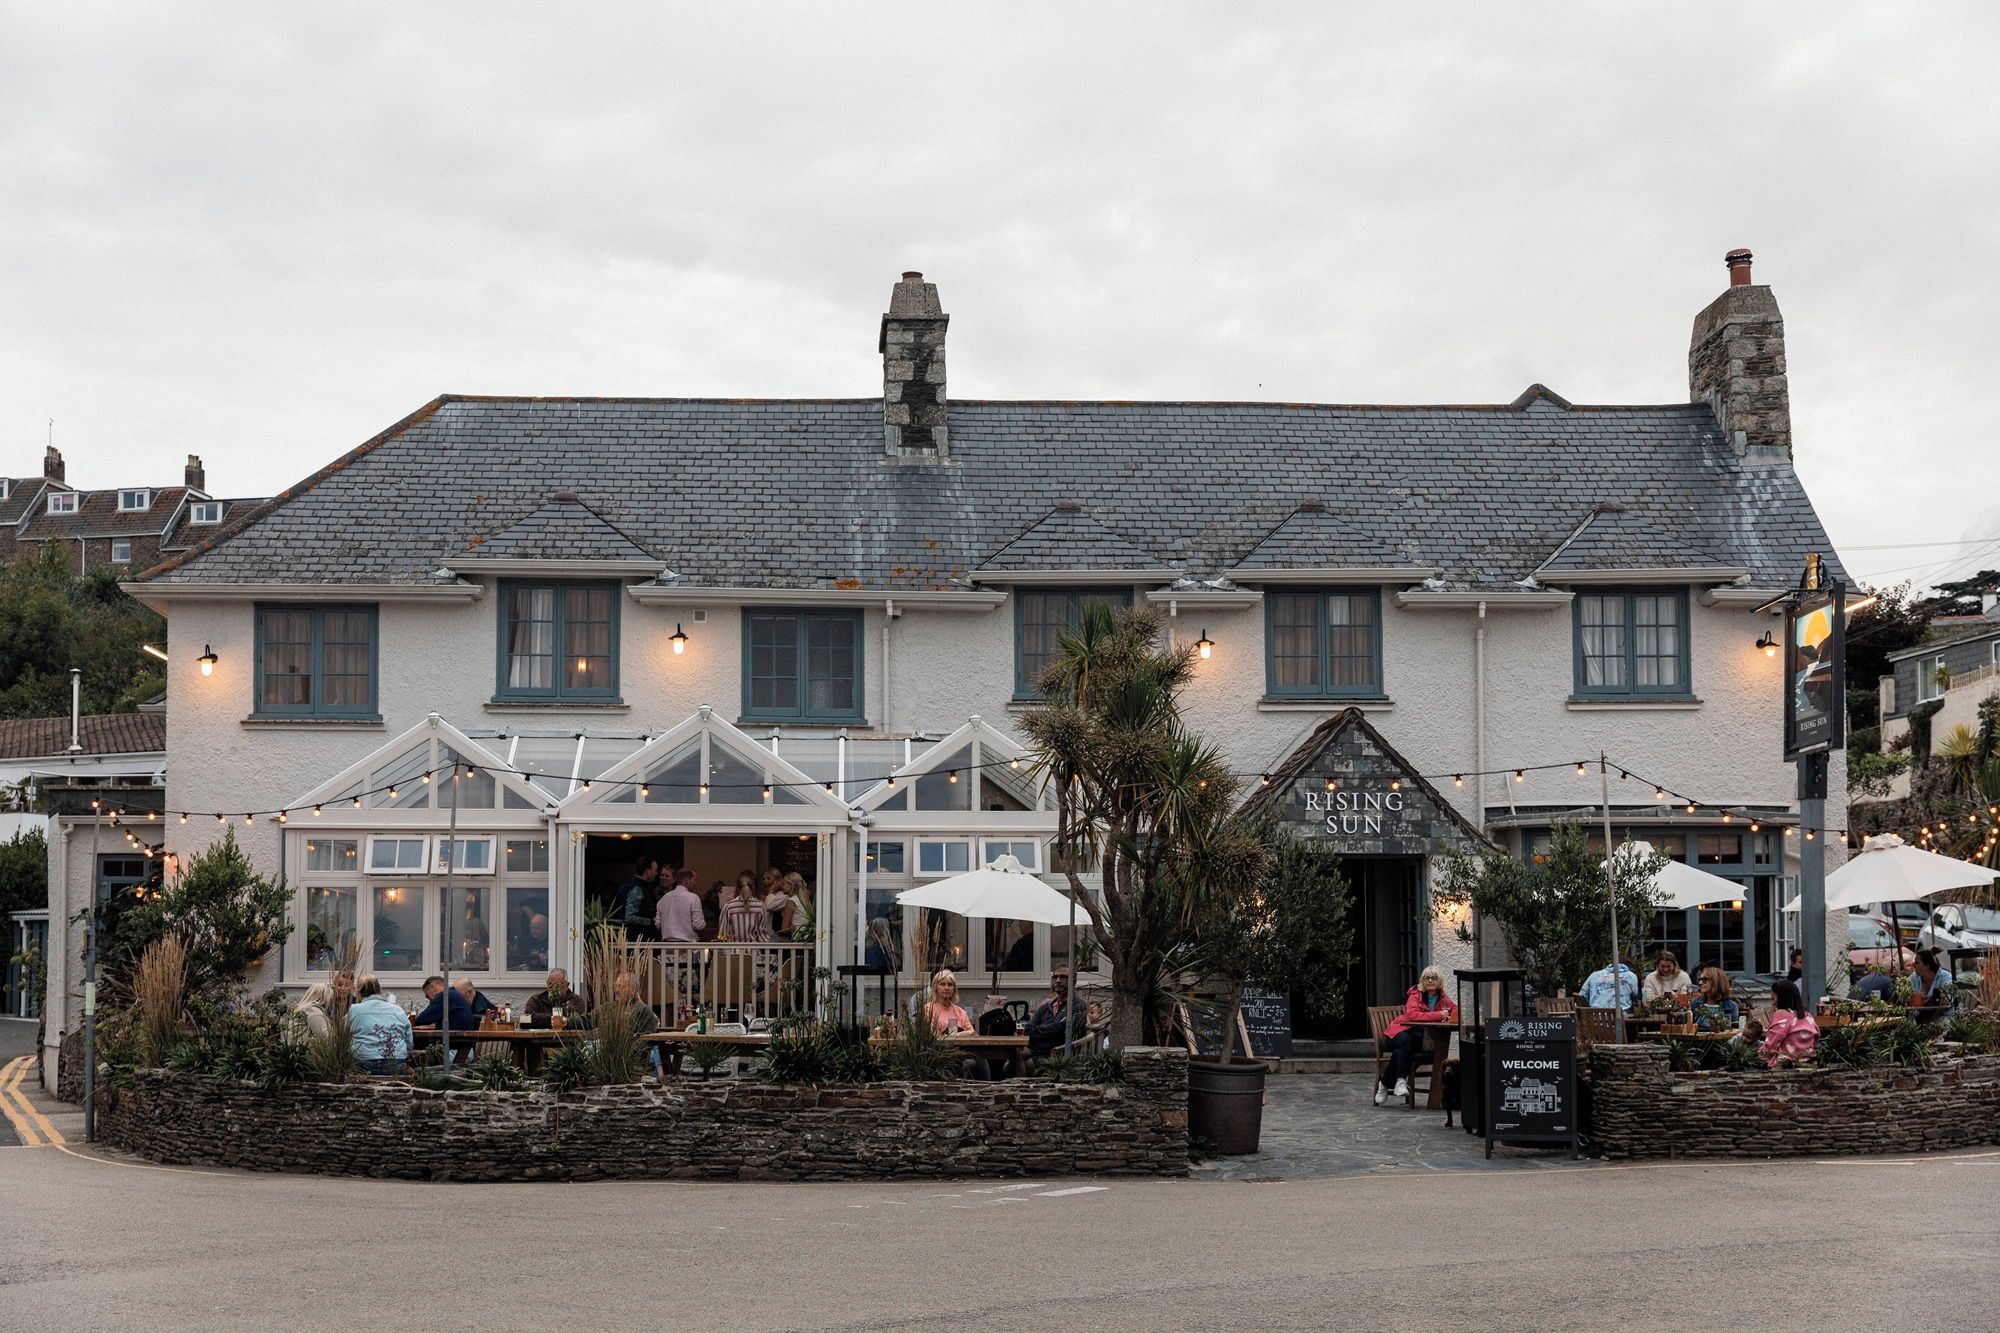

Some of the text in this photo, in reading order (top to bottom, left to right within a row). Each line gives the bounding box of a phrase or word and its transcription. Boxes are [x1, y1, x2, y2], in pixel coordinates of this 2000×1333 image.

[1800, 716, 1827, 731] RISING SUN
[1304, 792, 1403, 811] RISING
[1326, 815, 1383, 834] SUN
[1502, 1060, 1559, 1069] WELCOME
